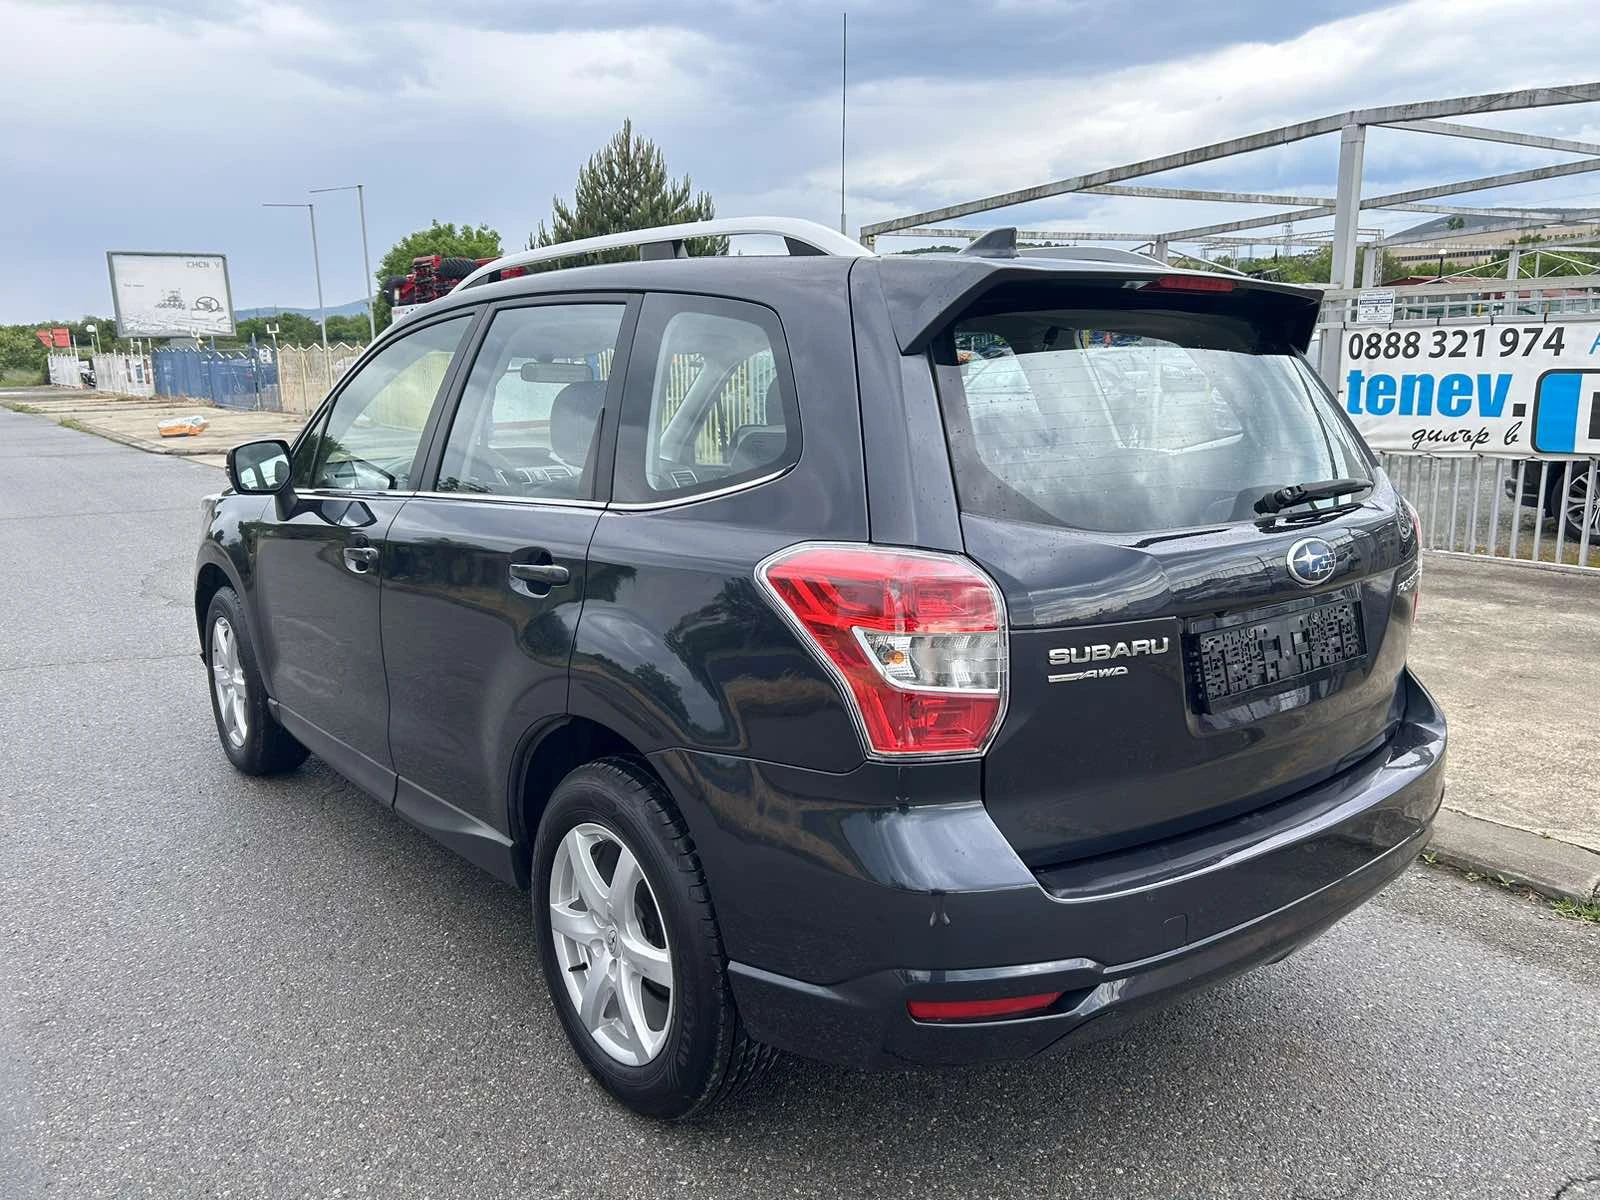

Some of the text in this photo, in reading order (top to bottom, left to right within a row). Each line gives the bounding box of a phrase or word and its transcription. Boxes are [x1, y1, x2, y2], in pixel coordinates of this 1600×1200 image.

[1348, 331, 1421, 361] 0888
[1428, 329, 1485, 358] 321
[1499, 327, 1565, 357] 974
[1411, 421, 1522, 450] дилър в
[1048, 637, 1169, 666] SUBARU
[1076, 665, 1129, 681] AWD
